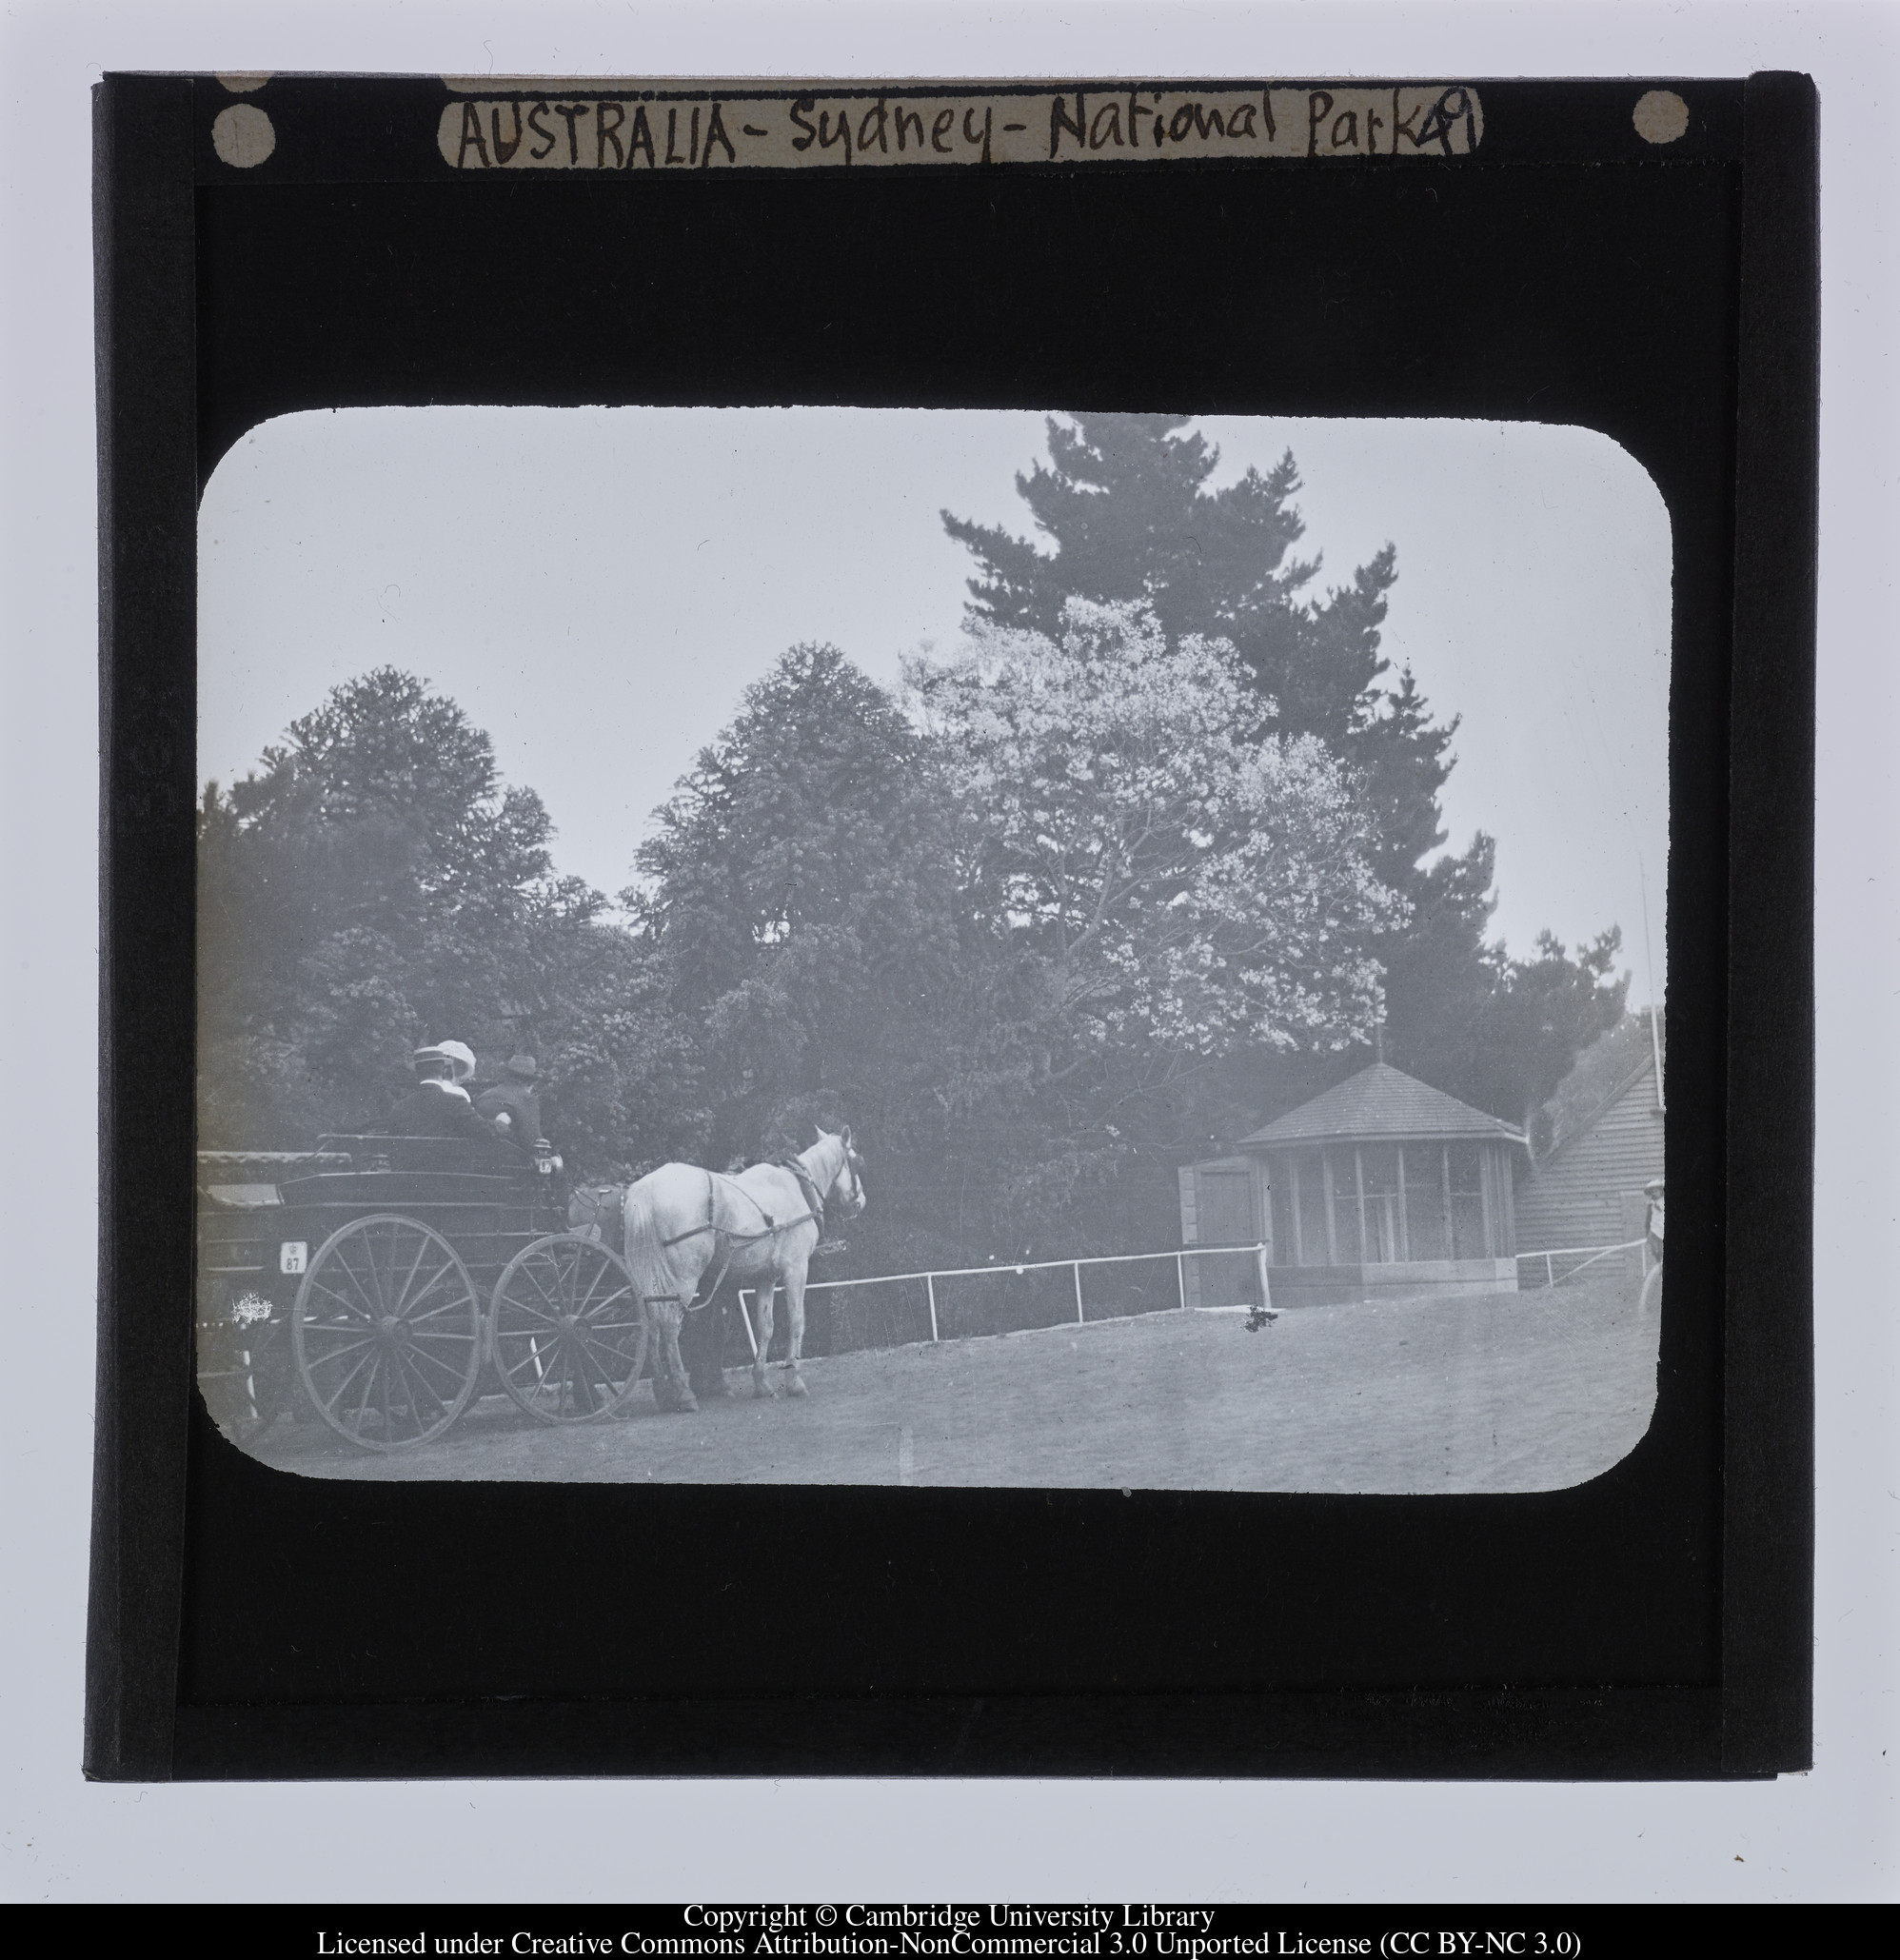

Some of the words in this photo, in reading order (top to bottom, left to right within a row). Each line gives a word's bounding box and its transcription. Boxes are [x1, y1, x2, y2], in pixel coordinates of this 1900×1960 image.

[1049, 88, 1276, 159] National
[1307, 88, 1422, 157] Park
[287, 1257, 300, 1271] 87
